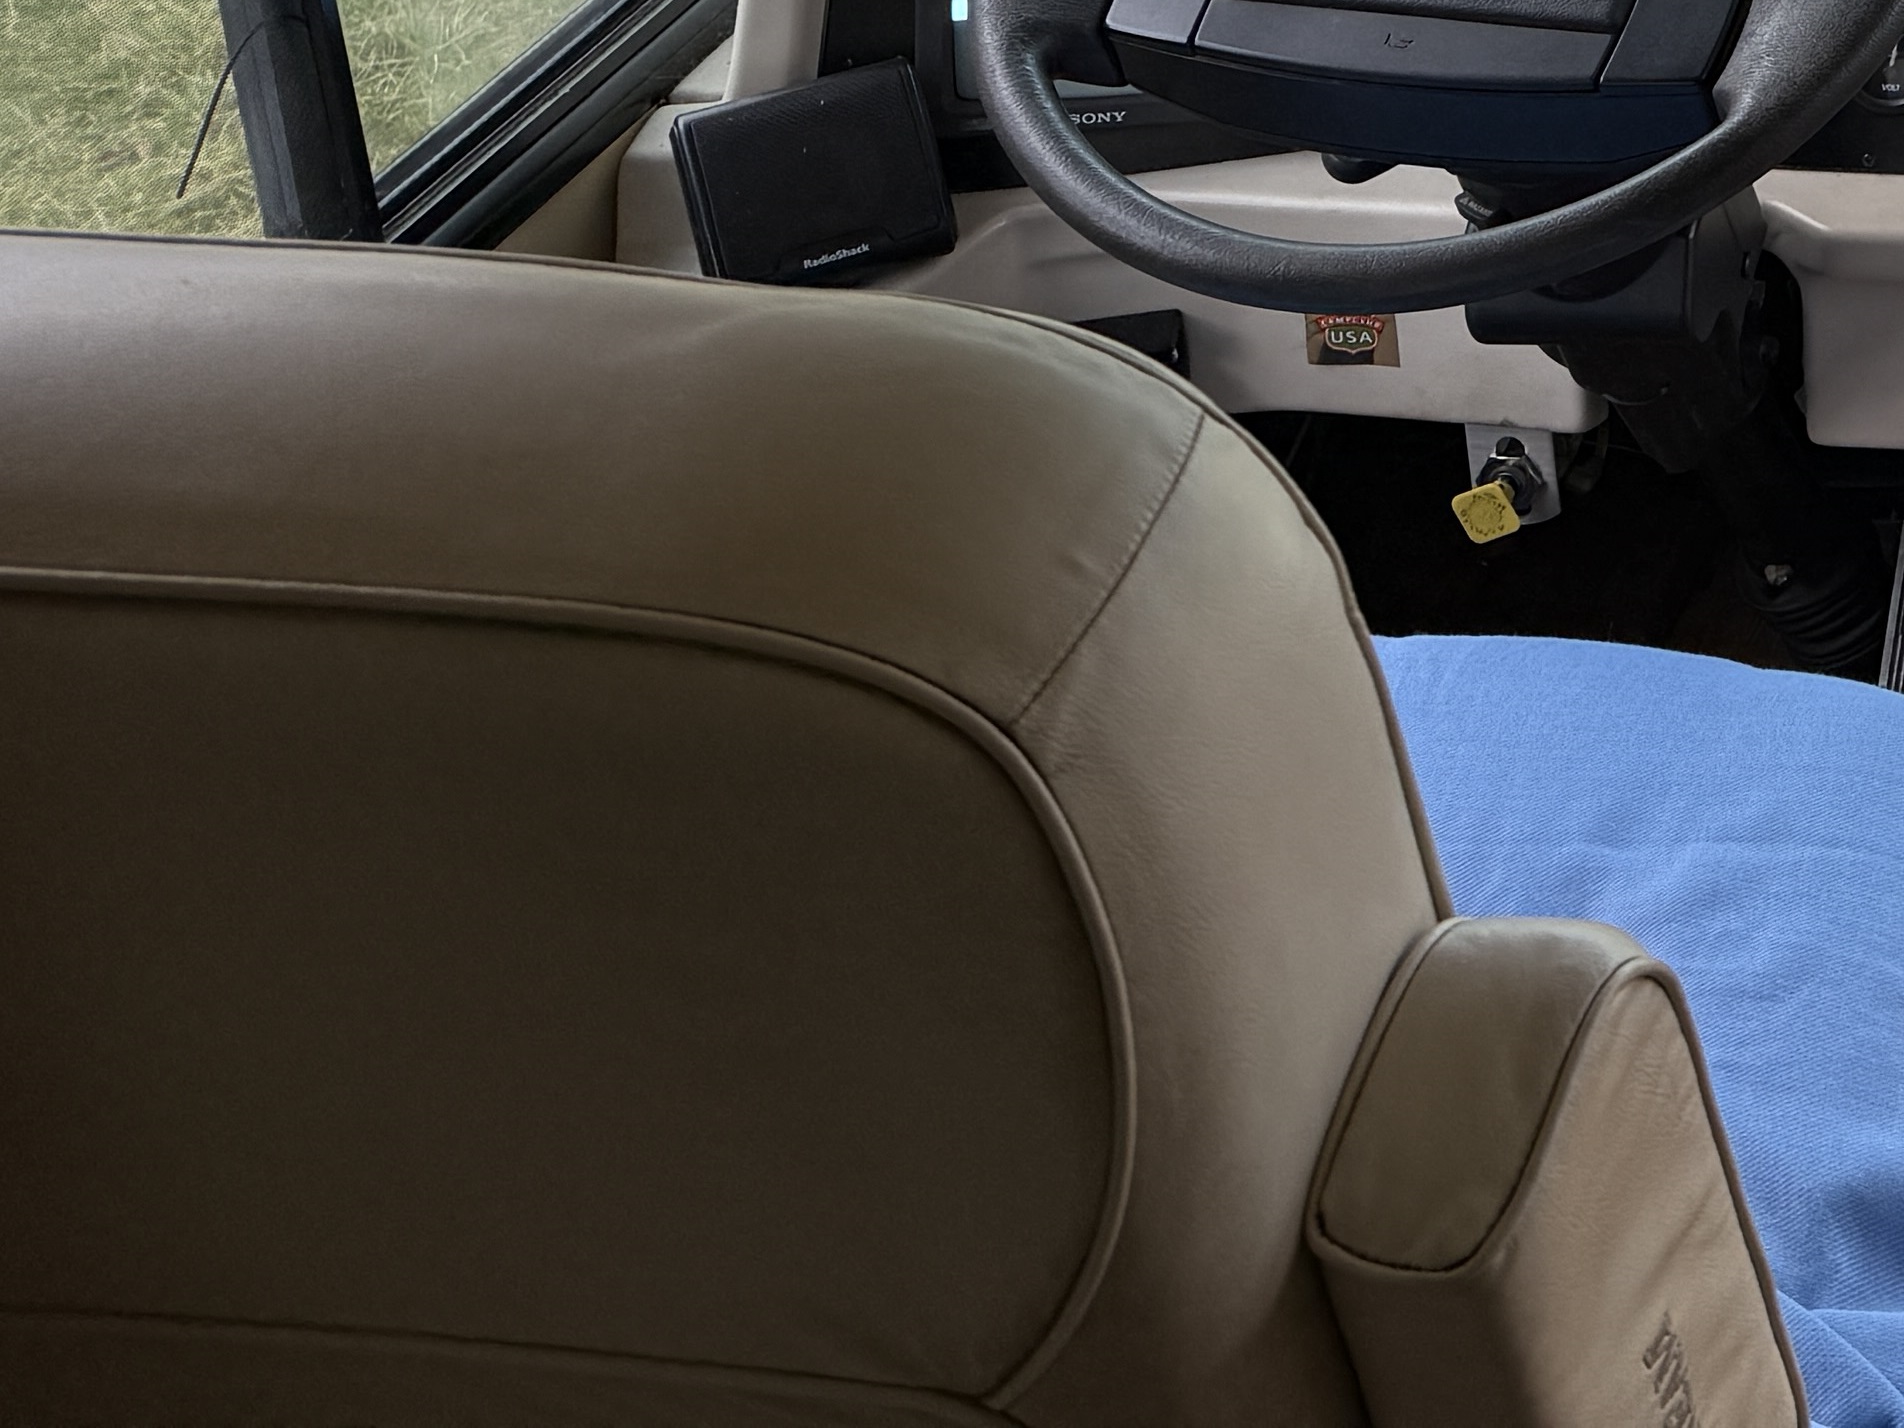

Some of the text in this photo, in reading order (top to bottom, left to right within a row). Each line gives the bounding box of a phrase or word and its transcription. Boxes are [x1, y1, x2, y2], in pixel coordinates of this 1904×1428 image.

[1881, 83, 1901, 92] VOLT
[1069, 110, 1127, 126] SONY
[802, 242, 871, 270] RadioShack
[1330, 330, 1373, 344] USA
